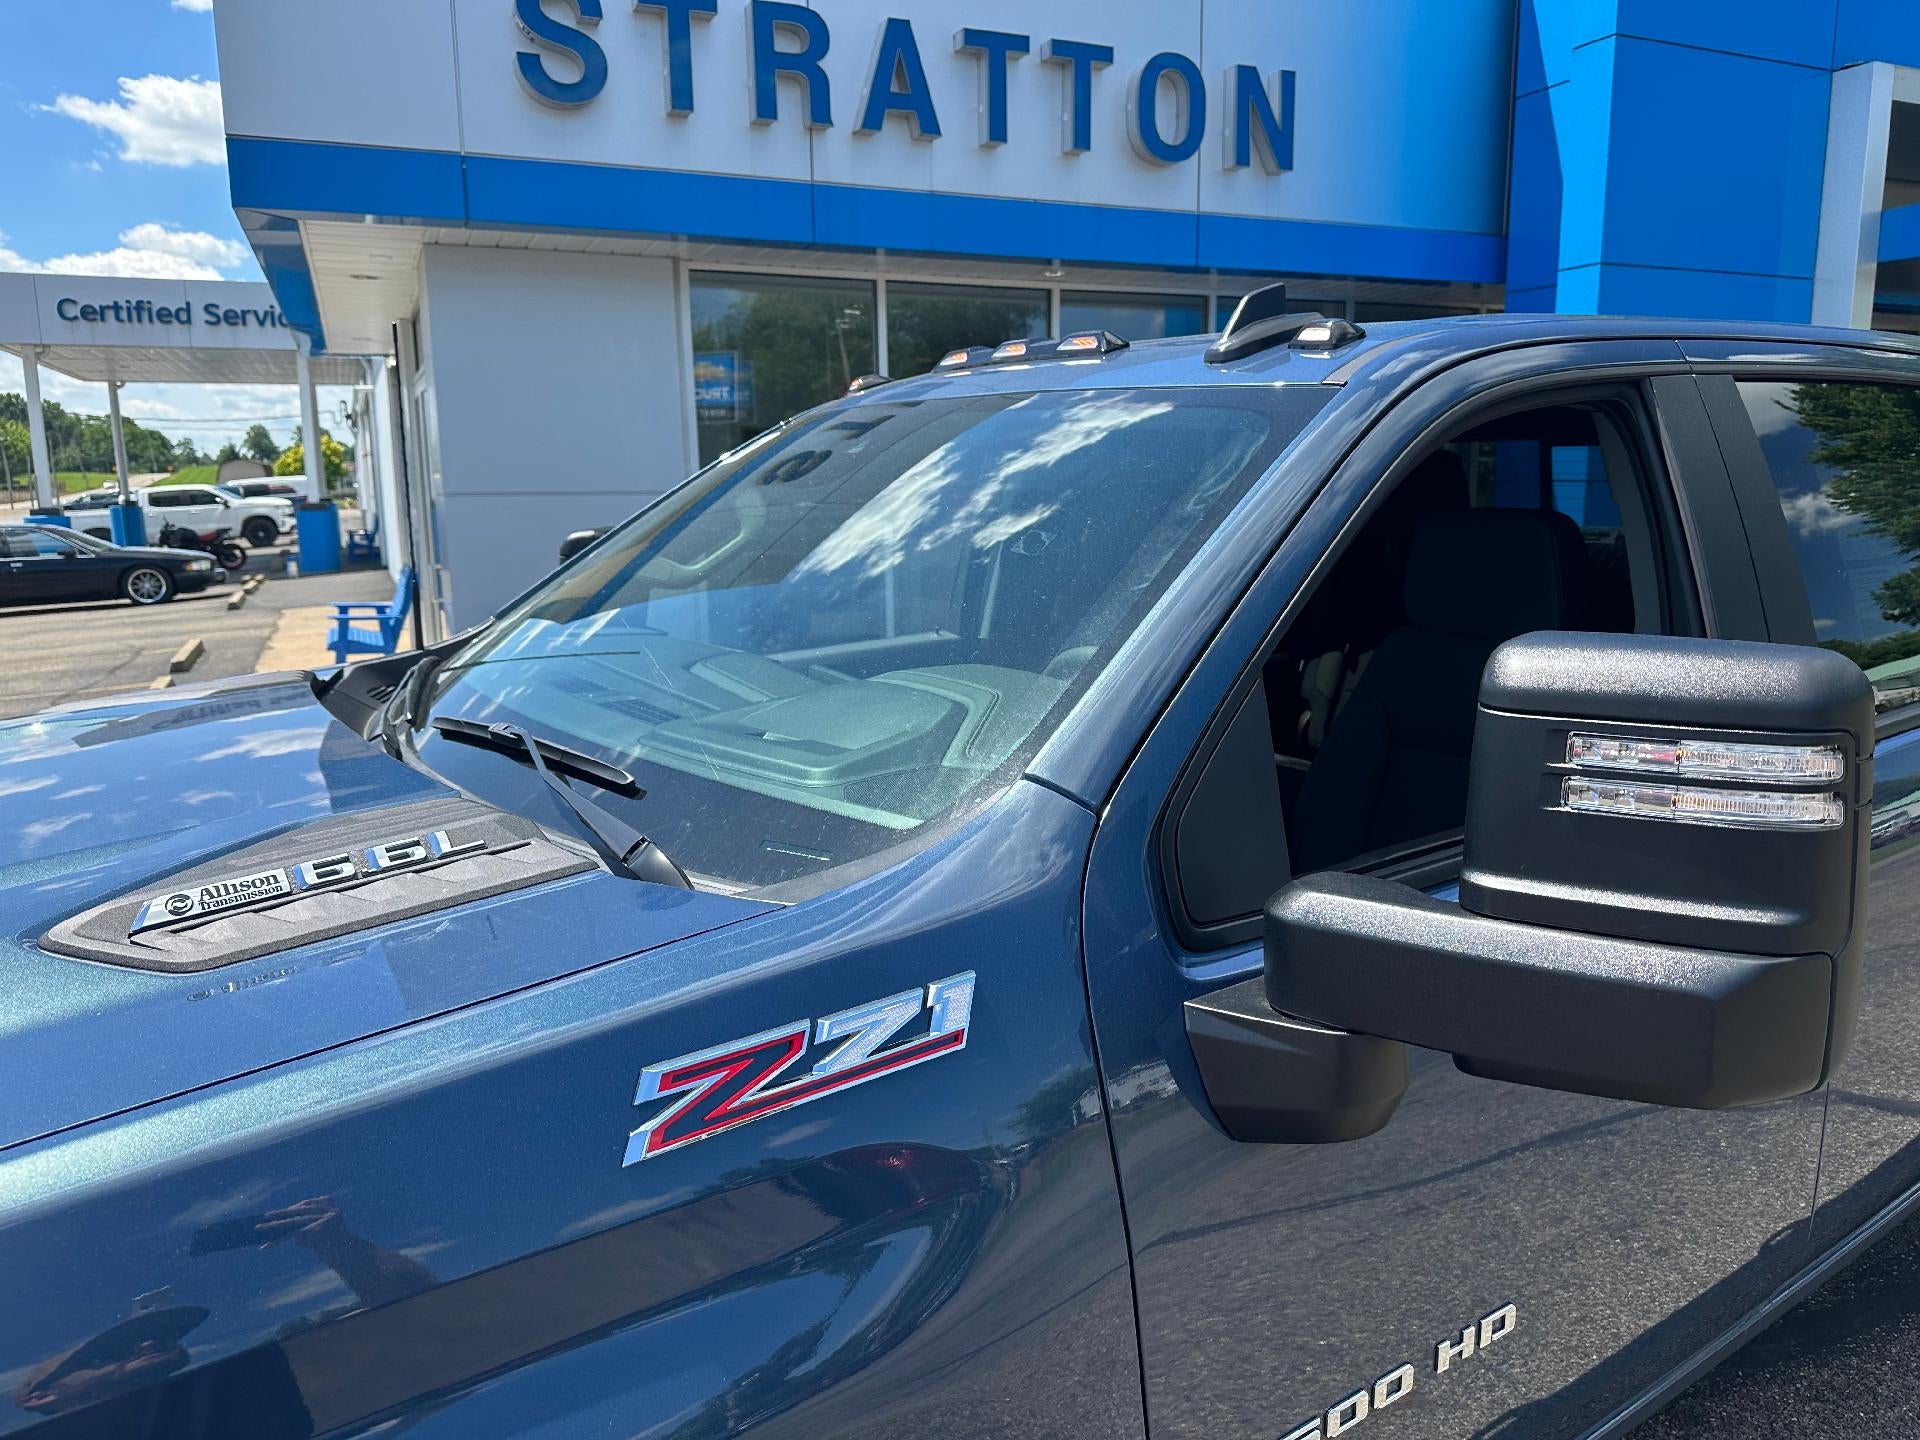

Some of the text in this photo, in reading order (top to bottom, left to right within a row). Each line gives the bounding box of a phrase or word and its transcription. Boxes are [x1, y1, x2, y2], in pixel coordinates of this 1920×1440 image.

[513, 0, 1297, 174] STRATTON
[56, 297, 289, 329] Certified Servic
[198, 885, 284, 911] Transmission
[199, 874, 281, 902] Allison
[622, 969, 977, 1169] Z71
[1434, 1303, 1517, 1375] HD
